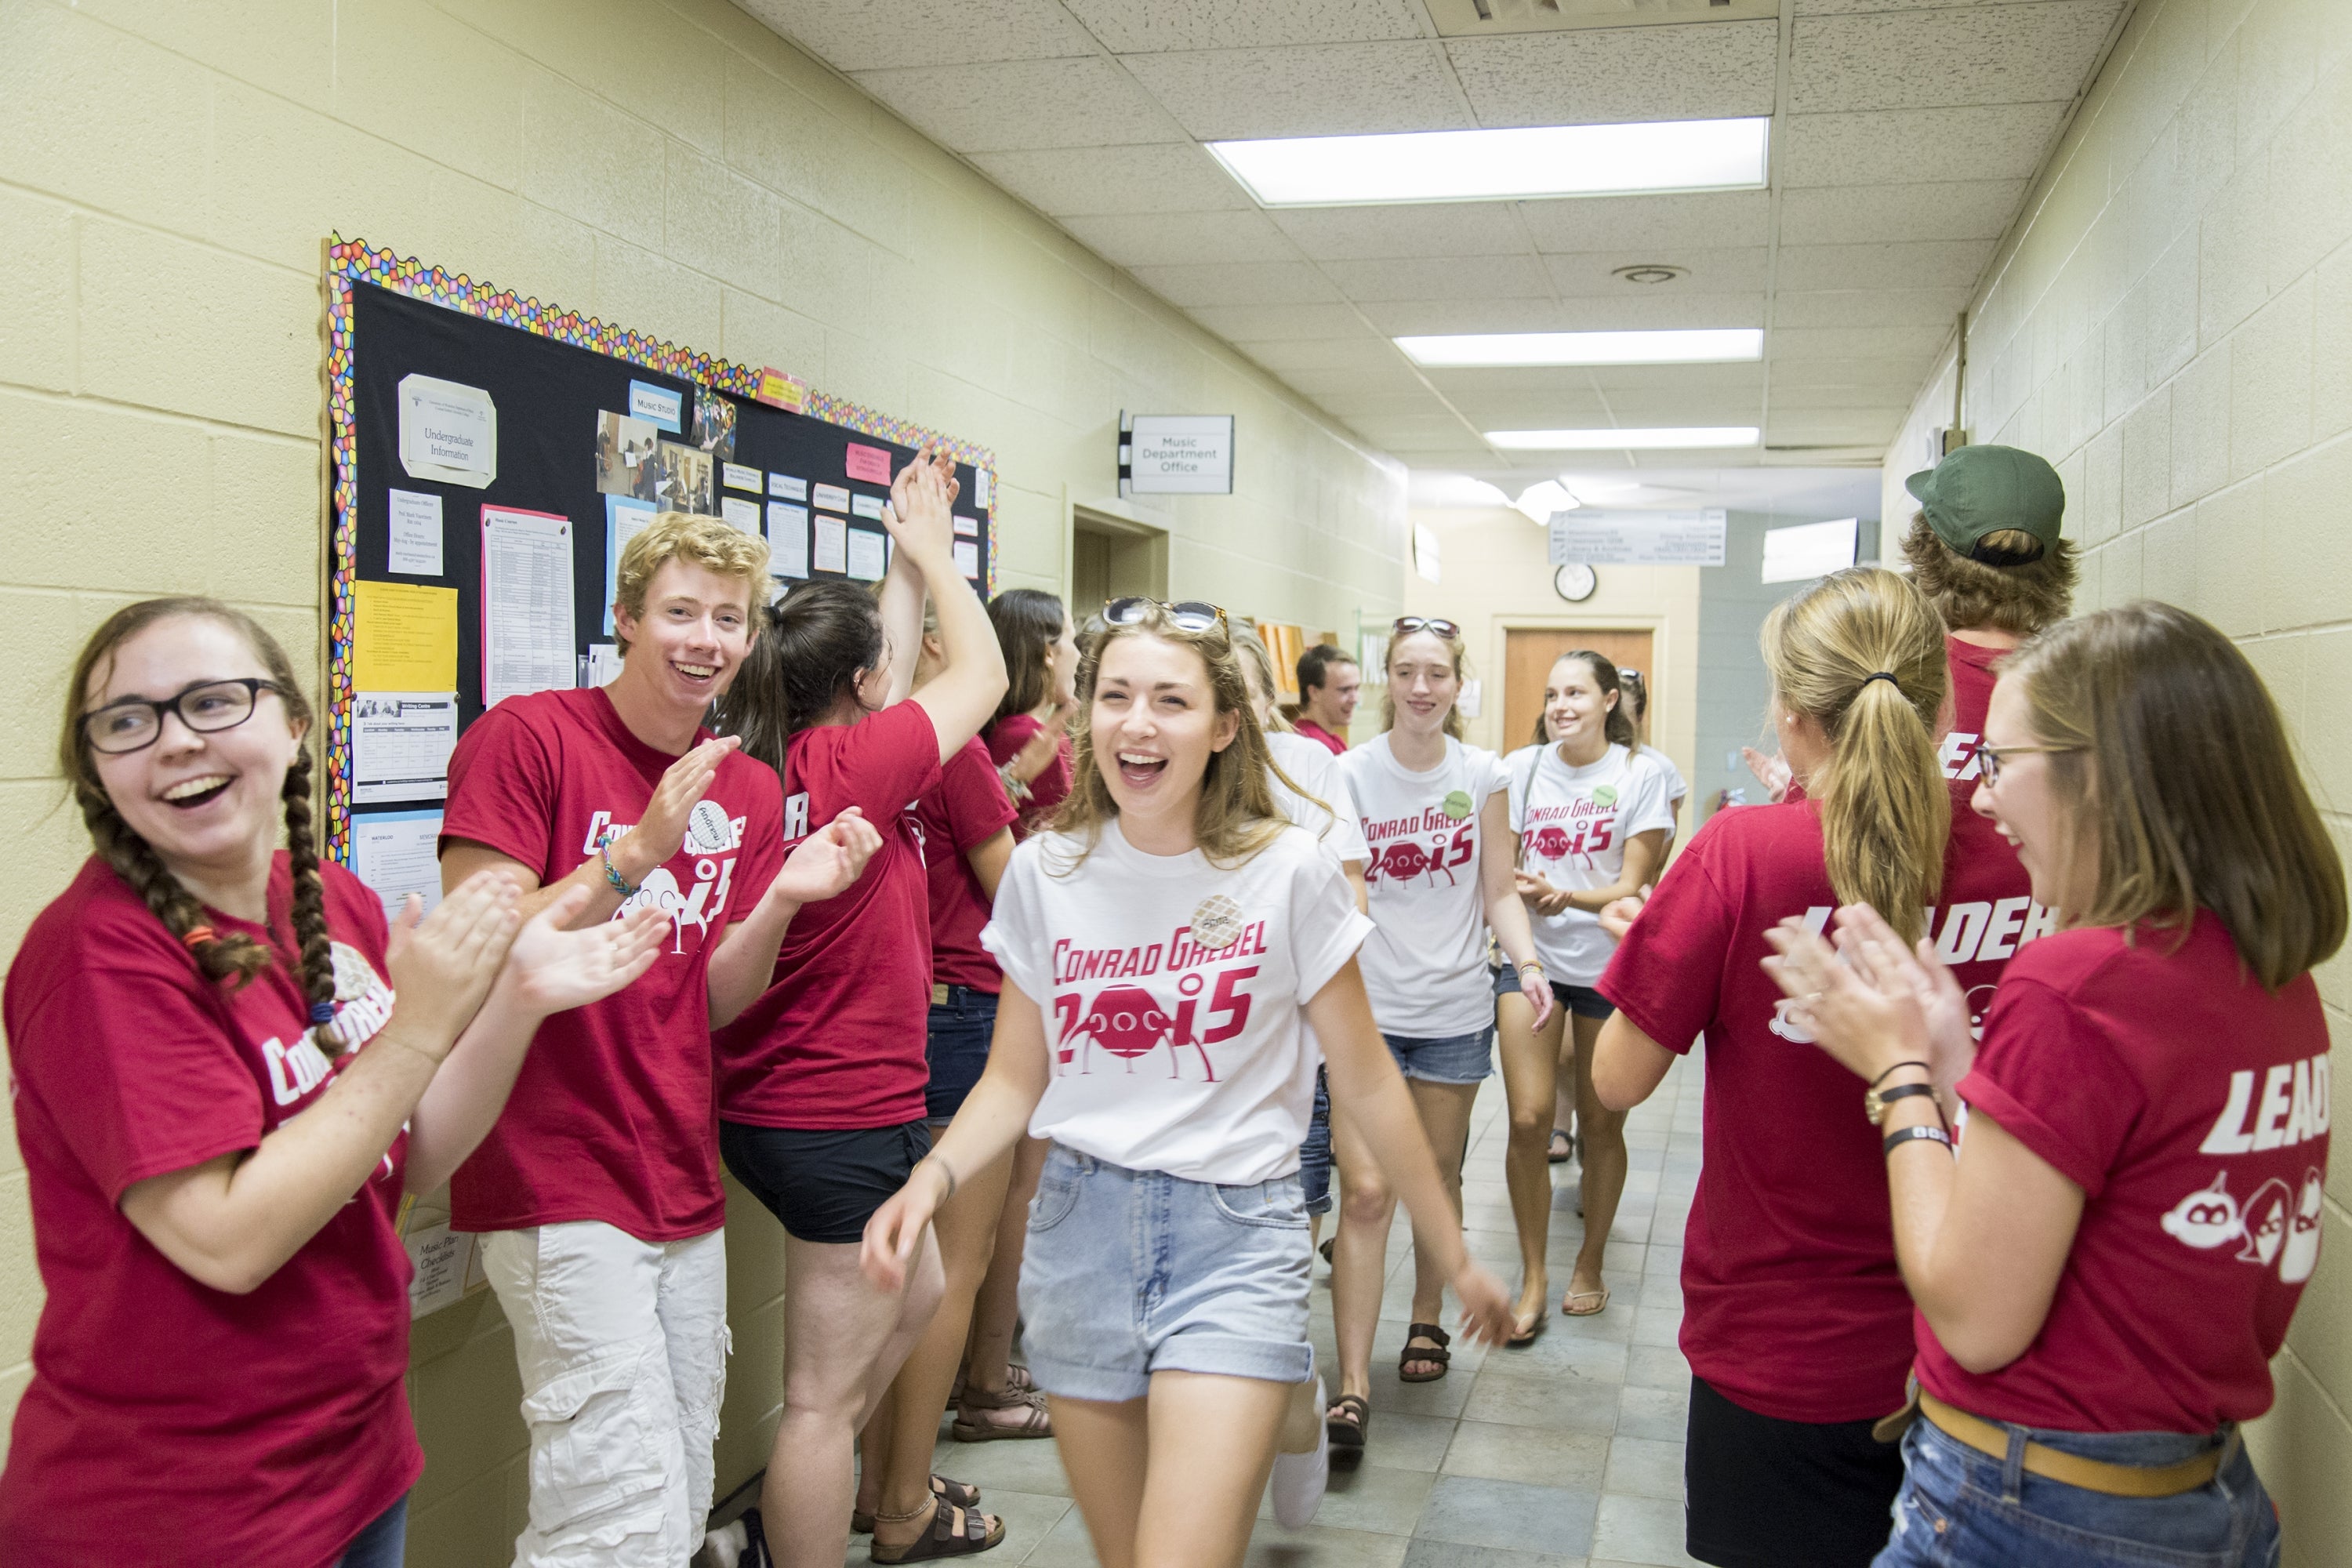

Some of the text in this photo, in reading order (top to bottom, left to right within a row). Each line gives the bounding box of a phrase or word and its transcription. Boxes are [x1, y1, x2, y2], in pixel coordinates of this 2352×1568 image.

[638, 398, 676, 416] MUSIC STUDIO
[424, 427, 474, 447] Undergraduate
[1162, 437, 1197, 448] Music
[431, 444, 469, 461] Information
[1142, 448, 1217, 459] Department
[1160, 461, 1199, 472] Office
[699, 807, 720, 841] Andrew
[1525, 804, 1570, 825] ONRAD
[1784, 896, 2061, 967] LDER
[1054, 938, 1163, 986] CONRAD
[420, 1235, 459, 1256] Music Plan
